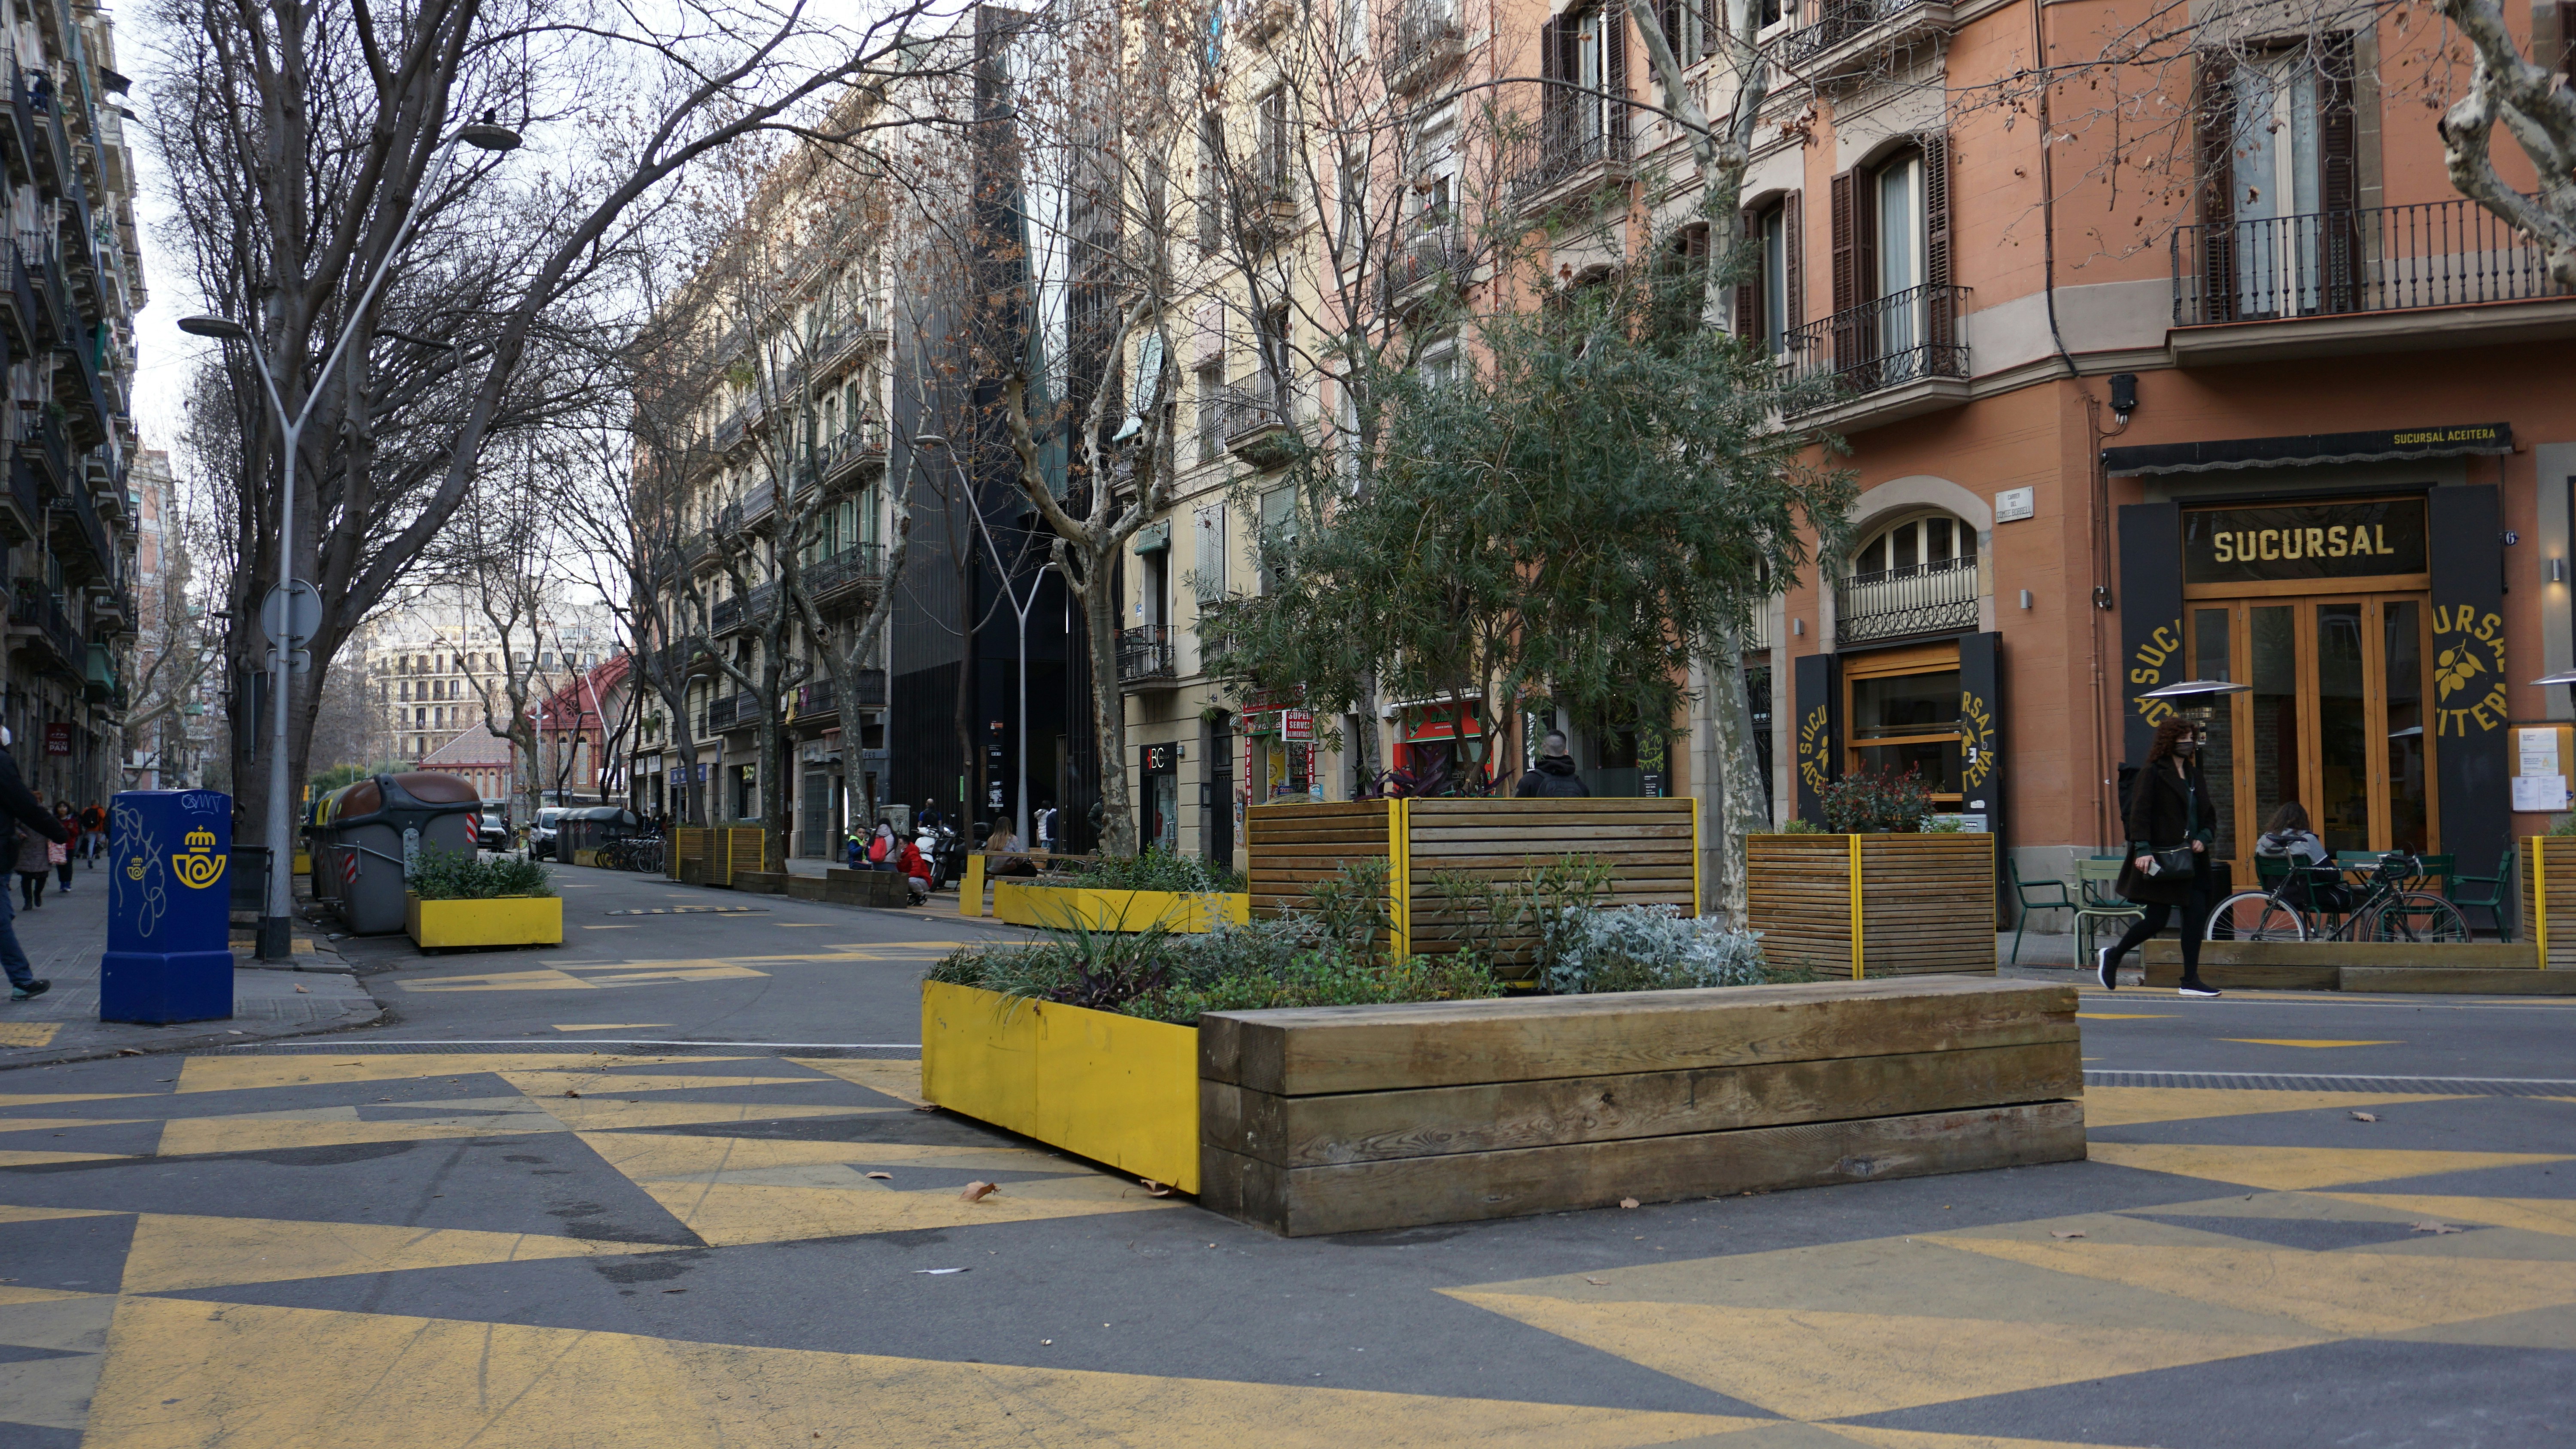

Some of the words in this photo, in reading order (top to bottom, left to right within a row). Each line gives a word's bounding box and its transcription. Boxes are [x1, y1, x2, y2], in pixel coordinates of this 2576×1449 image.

[2394, 432, 2445, 445] SUCURSAL
[2448, 428, 2496, 441] ACEITERA
[1997, 509, 2011, 519] COMTE
[2012, 505, 2032, 516] BORRELL
[2214, 524, 2394, 563] SUCURSAL
[2131, 618, 2180, 685] SUC
[1151, 747, 1164, 768] BC
